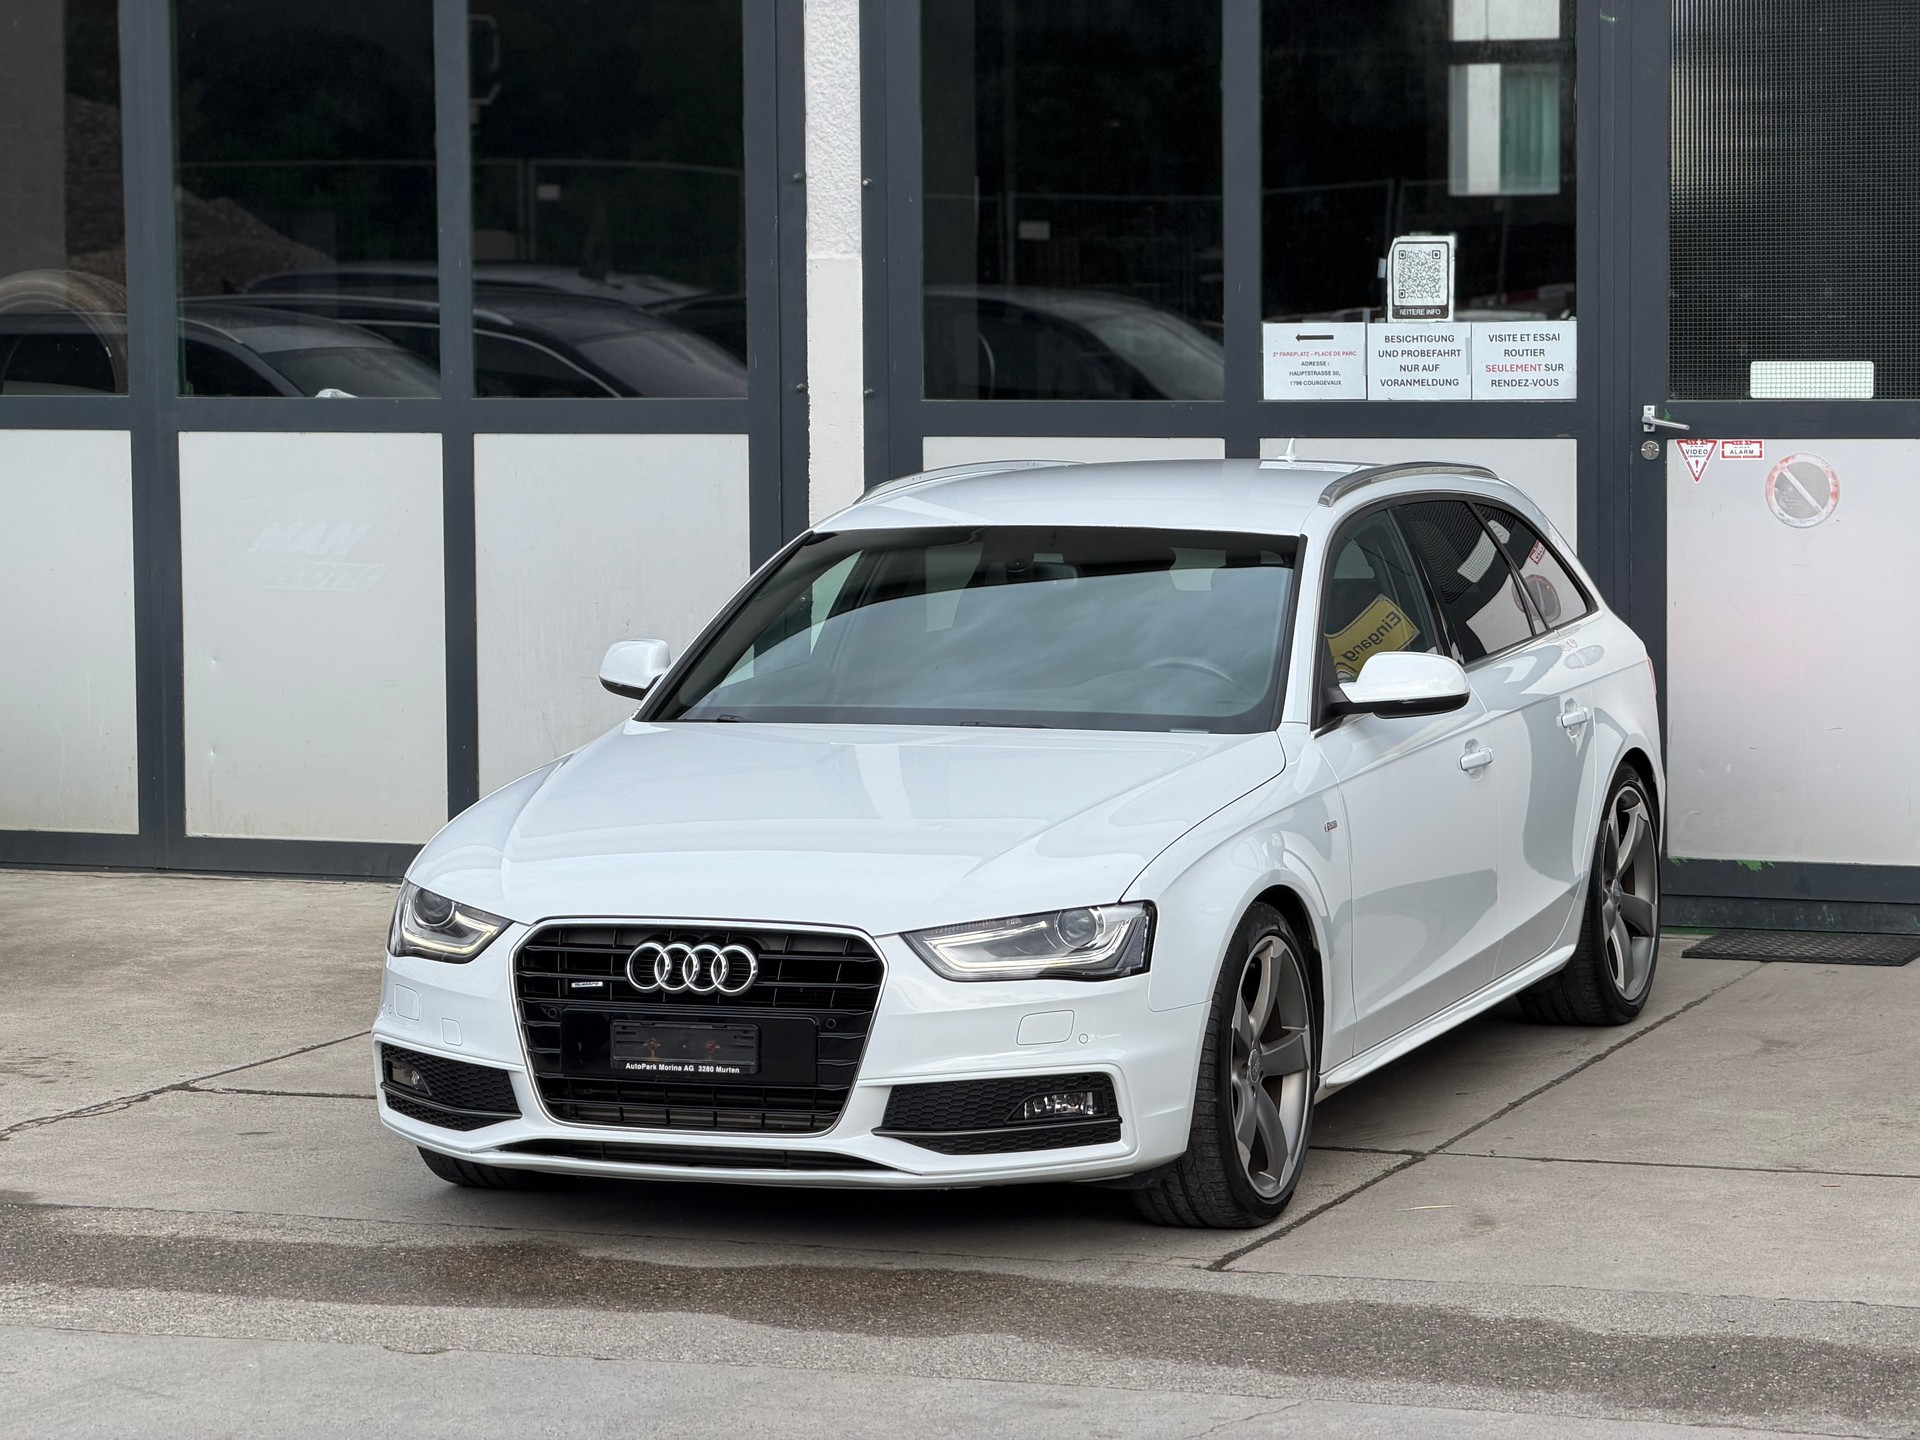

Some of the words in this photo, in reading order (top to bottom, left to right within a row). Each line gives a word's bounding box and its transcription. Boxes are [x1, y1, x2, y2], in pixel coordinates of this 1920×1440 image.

[1384, 334, 1455, 343] BESICHTIGUNG
[1488, 333, 1518, 342] VISITE
[1519, 333, 1531, 342] ET
[1533, 333, 1560, 341] ESSAI
[1378, 350, 1399, 358] UND
[1401, 349, 1461, 357] PROBEFAHRT
[1503, 348, 1545, 357] ROUTIER
[1399, 364, 1420, 372] NUR
[1421, 364, 1440, 372] AUF
[1485, 363, 1542, 372] SEULEMENT
[1544, 363, 1564, 372] SUR
[1379, 378, 1460, 387] VORANMELDUNG
[1490, 378, 1559, 387] RENDEZ-VOUS
[625, 1062, 657, 1070] AutoPark
[659, 1063, 682, 1071] Morina
[683, 1064, 695, 1072] AG
[697, 1065, 714, 1073] 3280
[715, 1066, 740, 1074] Murten
